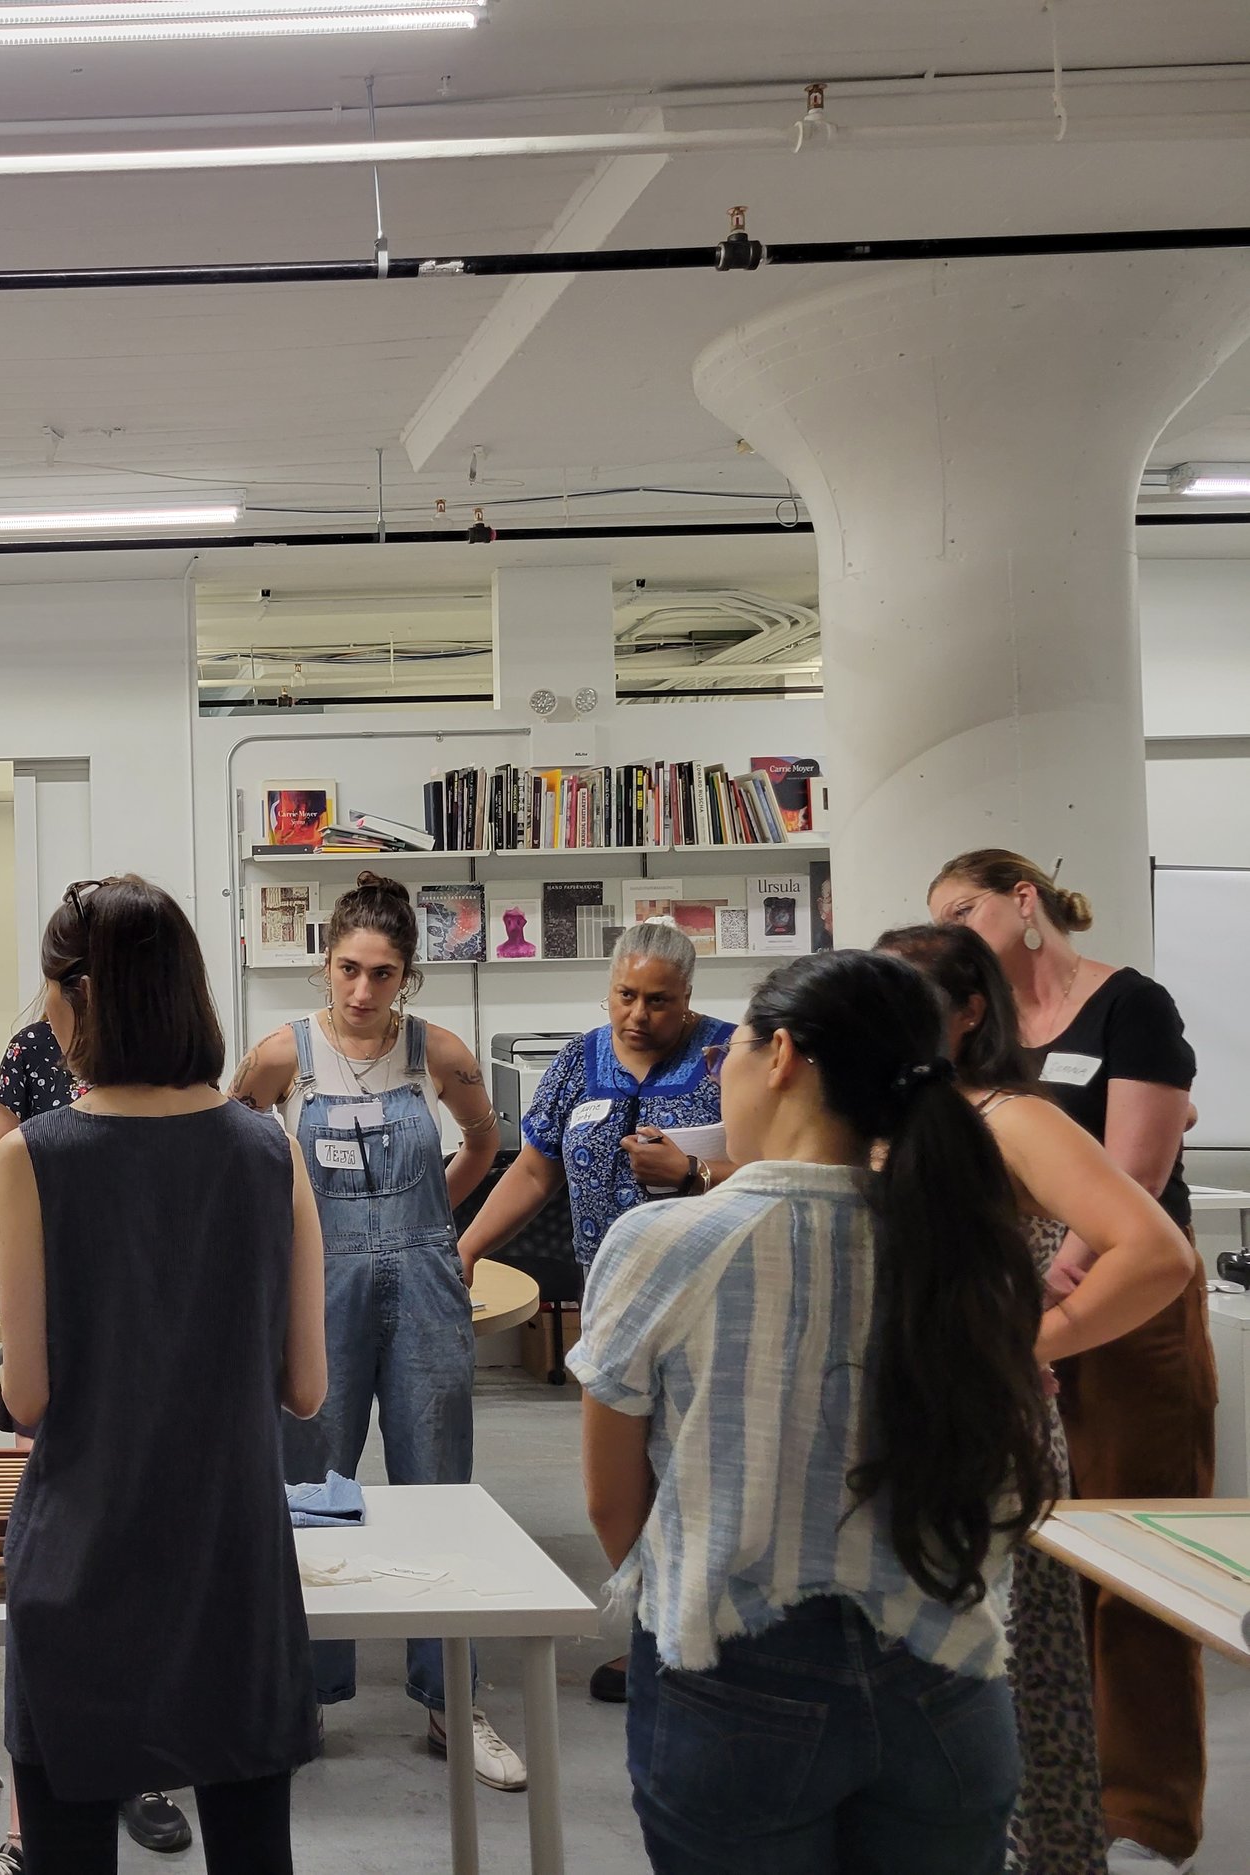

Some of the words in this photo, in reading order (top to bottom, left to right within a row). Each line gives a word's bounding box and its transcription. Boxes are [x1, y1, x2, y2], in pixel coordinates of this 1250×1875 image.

[769, 765, 791, 773] Carrie
[792, 764, 814, 774] Moyer
[278, 810, 298, 818] Carrie
[299, 810, 318, 819] Moyer
[758, 879, 801, 893] Ursula
[324, 1144, 356, 1165] TEJA
